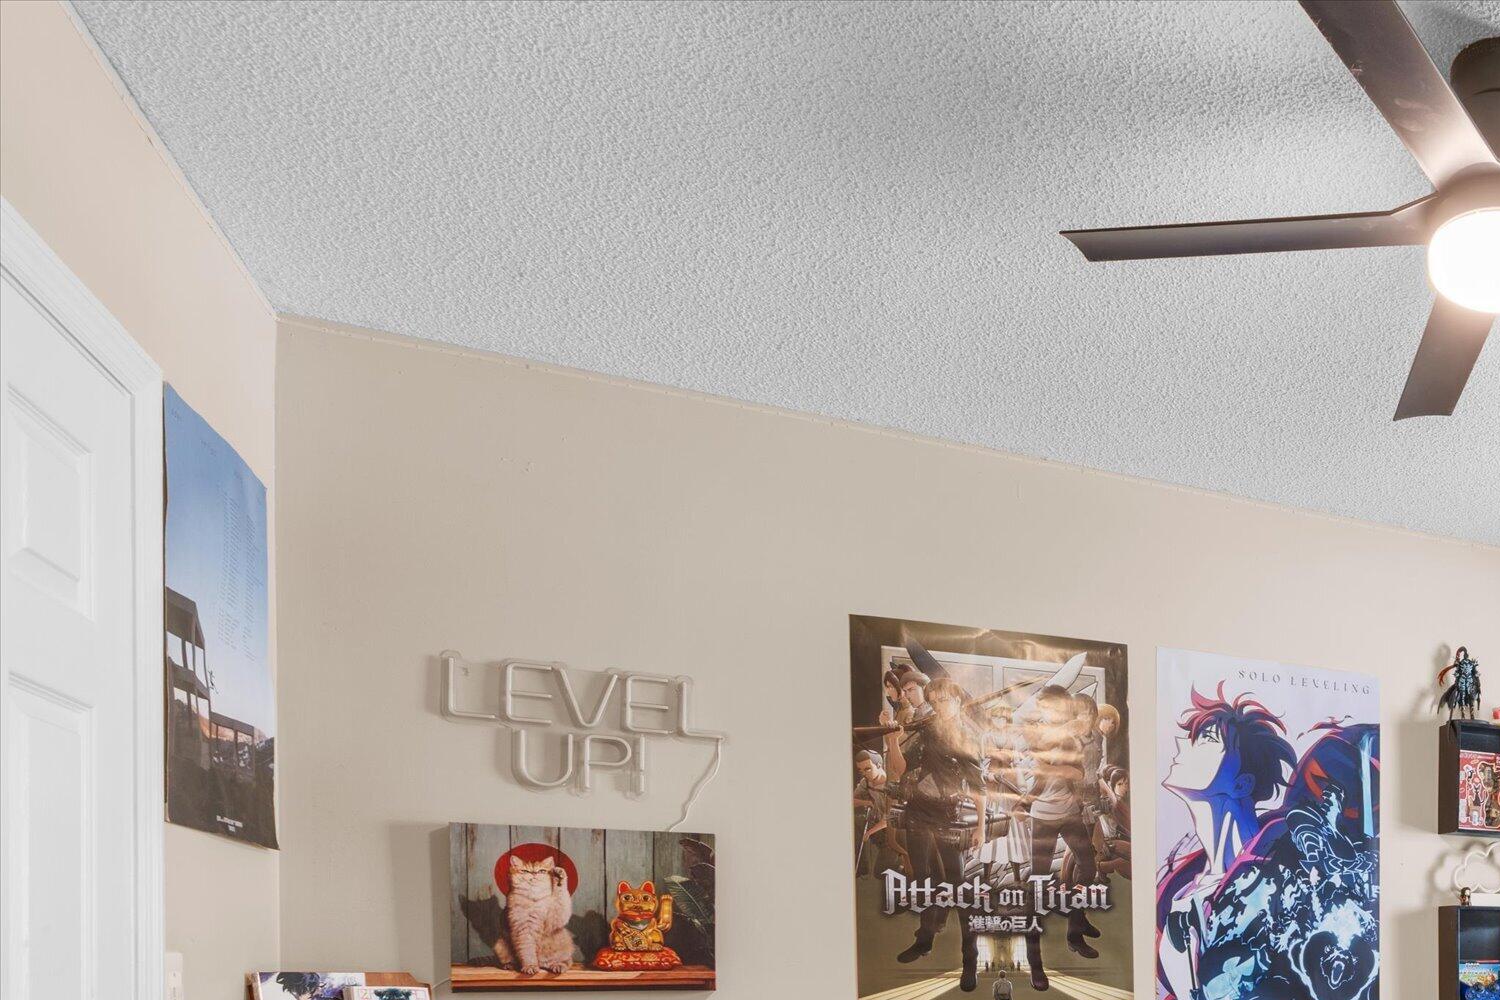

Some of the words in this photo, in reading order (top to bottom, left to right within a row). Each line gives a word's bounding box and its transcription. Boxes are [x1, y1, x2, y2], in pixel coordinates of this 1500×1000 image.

[446, 655, 725, 741] LEVEL
[1238, 670, 1281, 684] SOLO
[1290, 675, 1371, 695] LEVELING
[518, 728, 646, 794] UP!
[881, 868, 994, 915] Attack
[999, 887, 1027, 909] on
[1027, 874, 1113, 916] Titan
